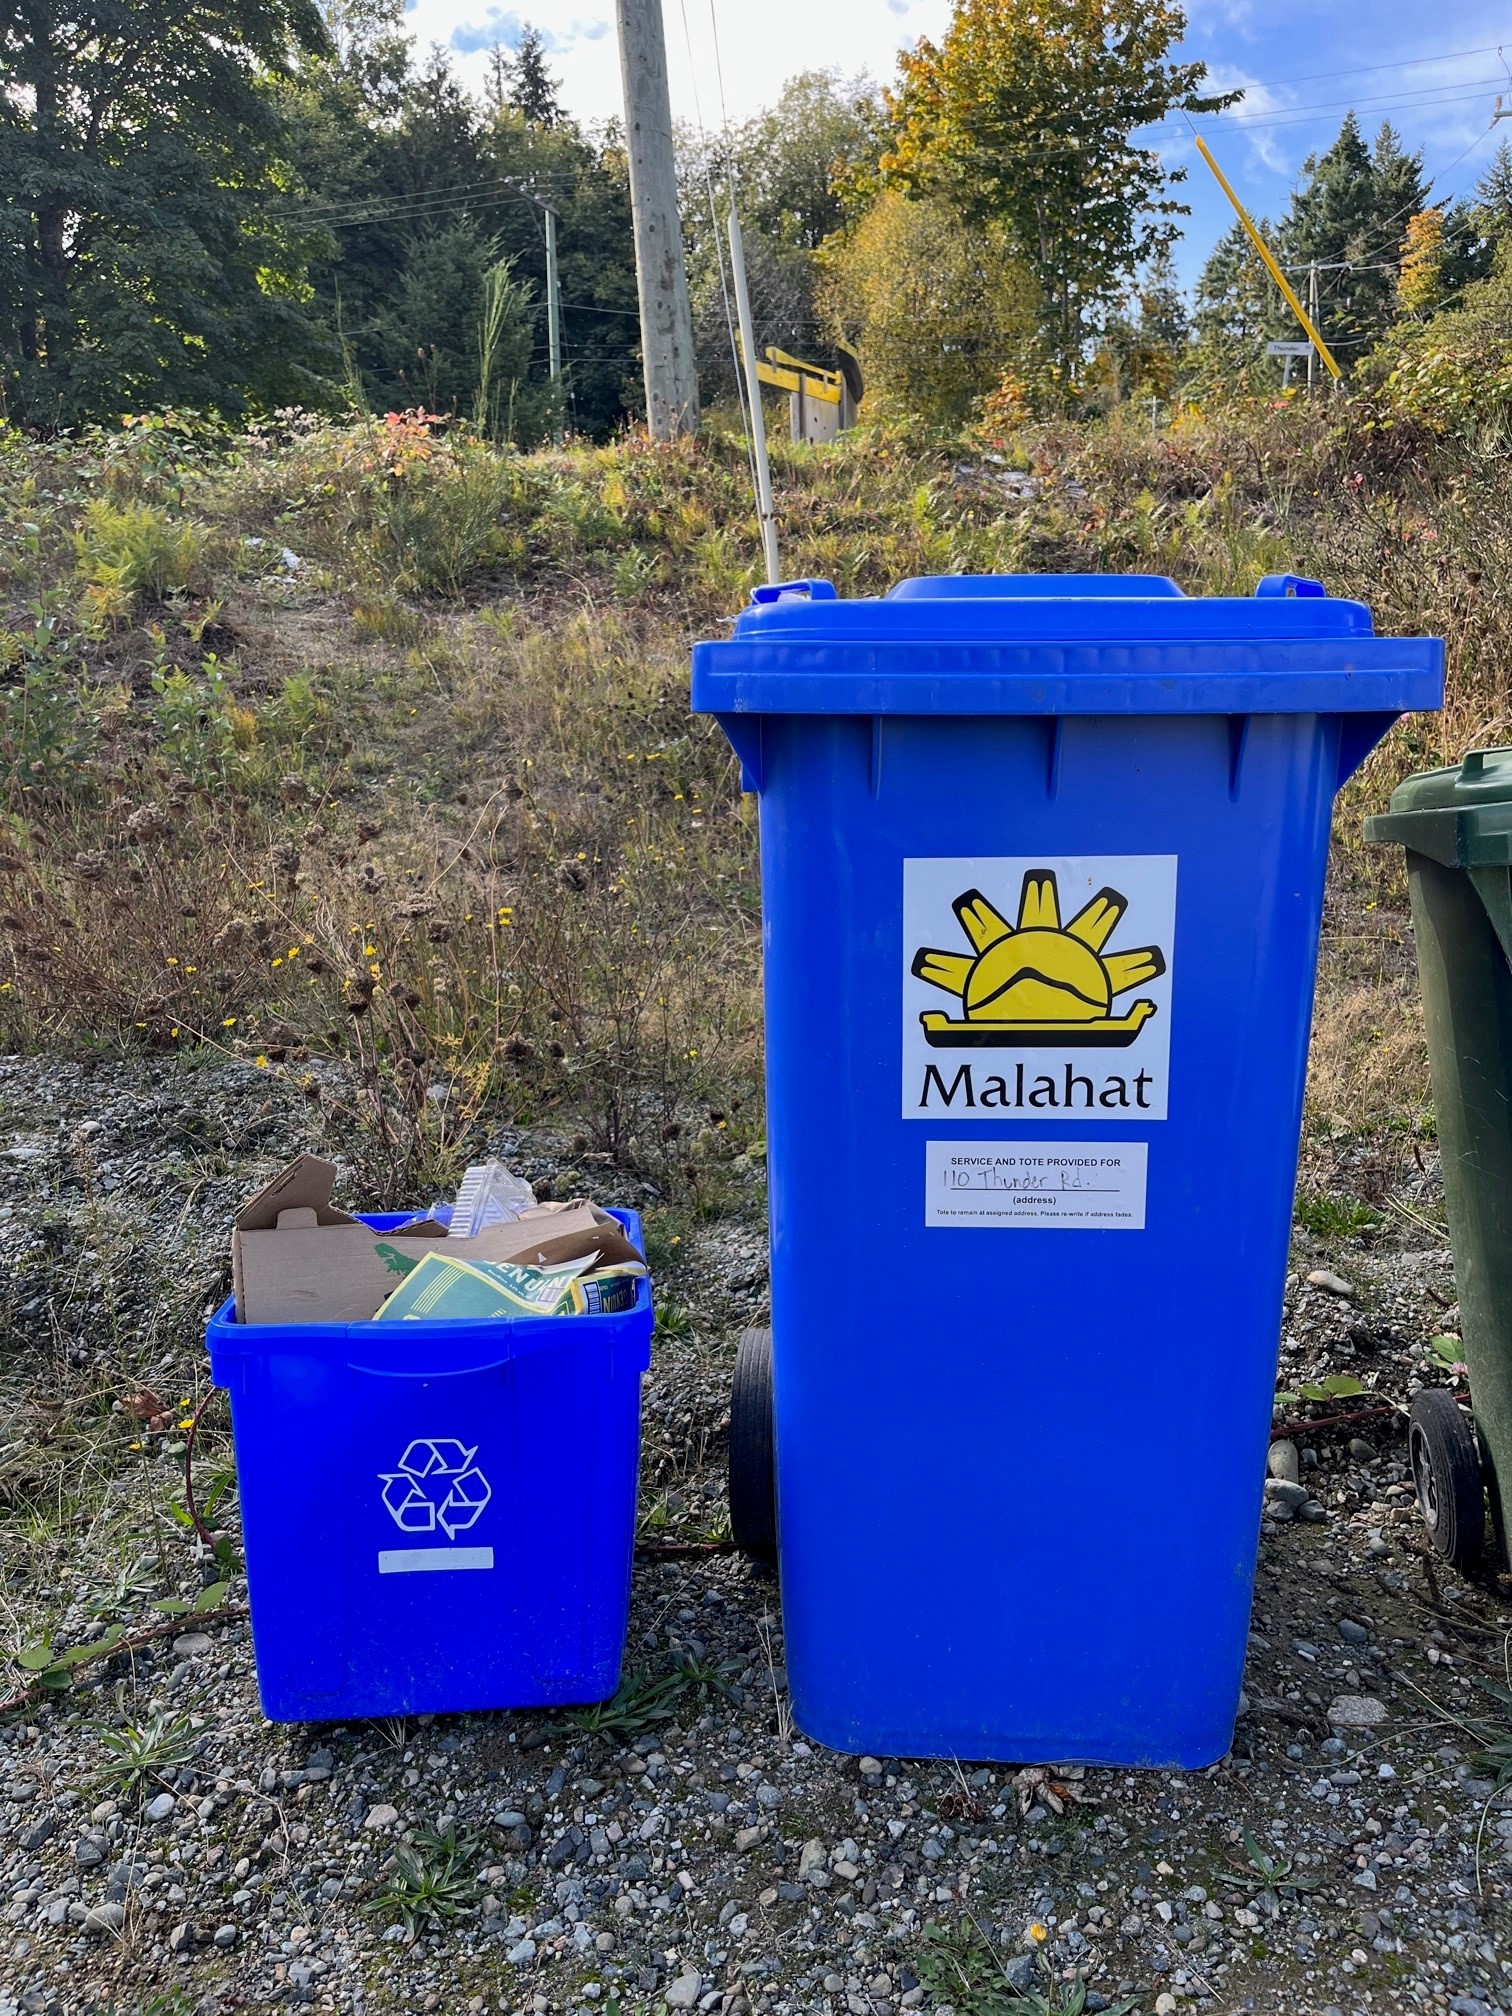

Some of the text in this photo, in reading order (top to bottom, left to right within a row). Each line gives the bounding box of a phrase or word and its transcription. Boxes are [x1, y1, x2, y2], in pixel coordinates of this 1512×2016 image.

[918, 1063, 1153, 1108] Malahat
[951, 1157, 1121, 1167] SERVICE AND TOTE PROVIDED FOR
[943, 1170, 970, 1188] 110
[978, 1166, 1048, 1190] Thunder
[1012, 1196, 1057, 1205] (address)
